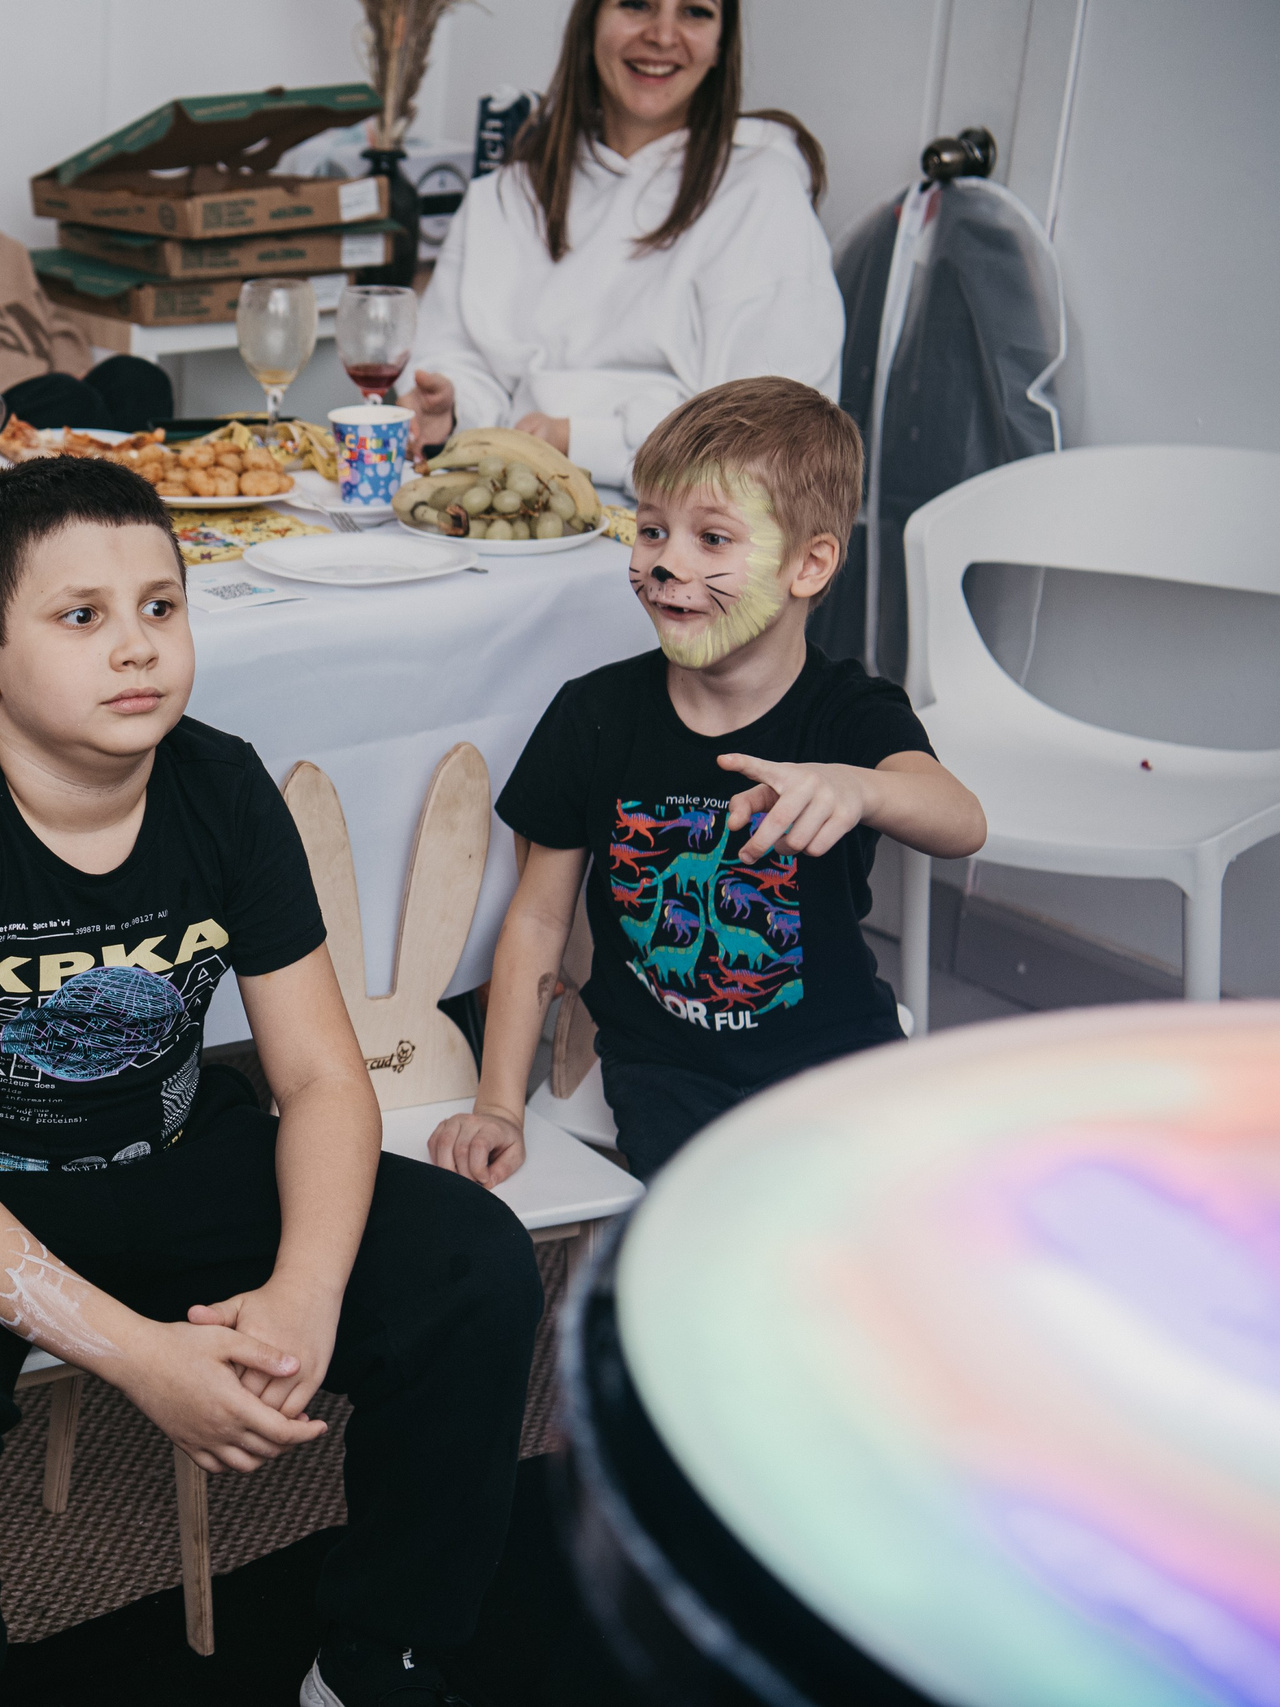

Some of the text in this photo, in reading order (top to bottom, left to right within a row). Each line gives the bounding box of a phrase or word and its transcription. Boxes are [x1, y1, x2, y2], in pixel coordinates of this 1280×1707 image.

[665, 794, 730, 809] make your
[105, 923, 116, 931] km
[34, 1081, 56, 1090] does
[19, 1114, 31, 1122] of
[35, 1116, 89, 1125] proteins).
